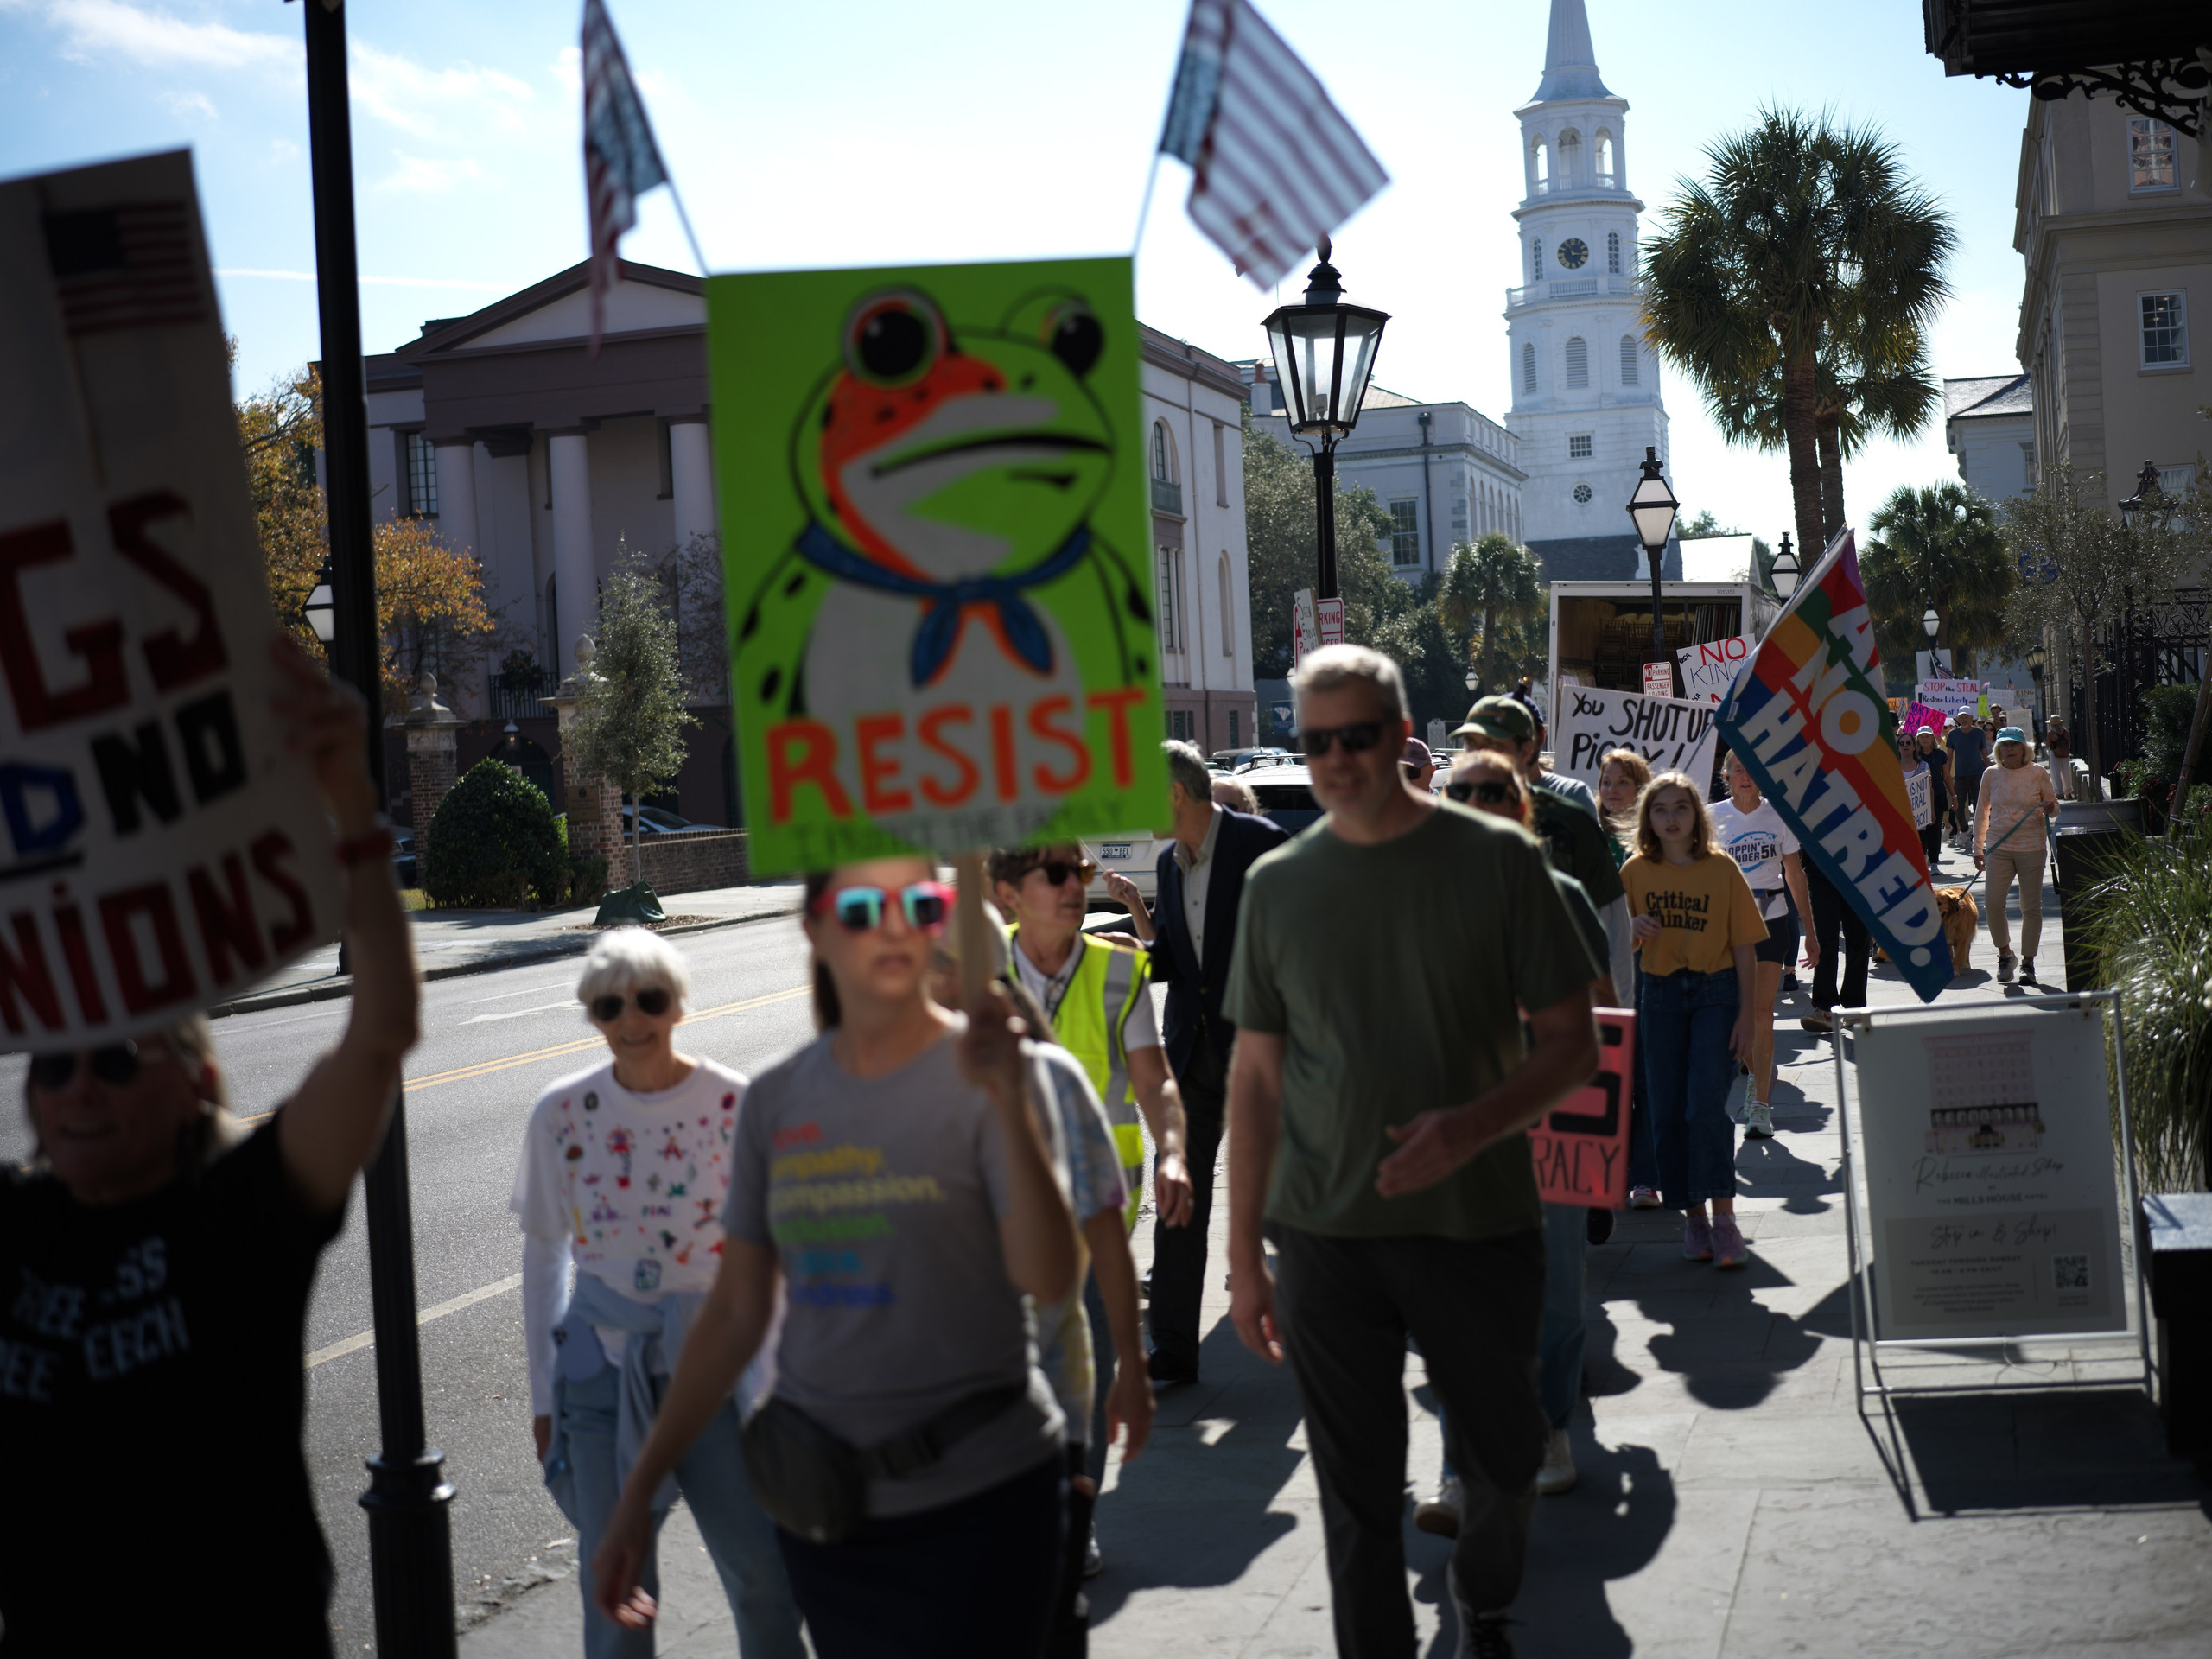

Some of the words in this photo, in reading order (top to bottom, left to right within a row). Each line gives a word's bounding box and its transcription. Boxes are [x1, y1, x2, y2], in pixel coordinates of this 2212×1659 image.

[1679, 652, 1692, 664] USA
[1699, 637, 1746, 666] NO
[1644, 668, 1652, 678] NO
[1652, 668, 1669, 677] PARKING
[1647, 681, 1669, 690] PASSENGER
[1923, 682, 1946, 692] STOP
[1956, 682, 1980, 693] STEAL
[1789, 635, 1879, 755] NO
[1923, 695, 1944, 703] Restore
[1945, 695, 1968, 705] Liberty
[1572, 692, 1605, 717] You
[766, 688, 1146, 827] RESIST
[1916, 776, 1929, 792] NOT
[1910, 792, 1926, 811] ERAL
[1738, 687, 1942, 967] HATRED.
[1761, 844, 1777, 859] 5K
[1645, 890, 1710, 913] Critical
[1953, 1195, 1984, 1205] MILLS
[1986, 1192, 2022, 1204] HOUSE
